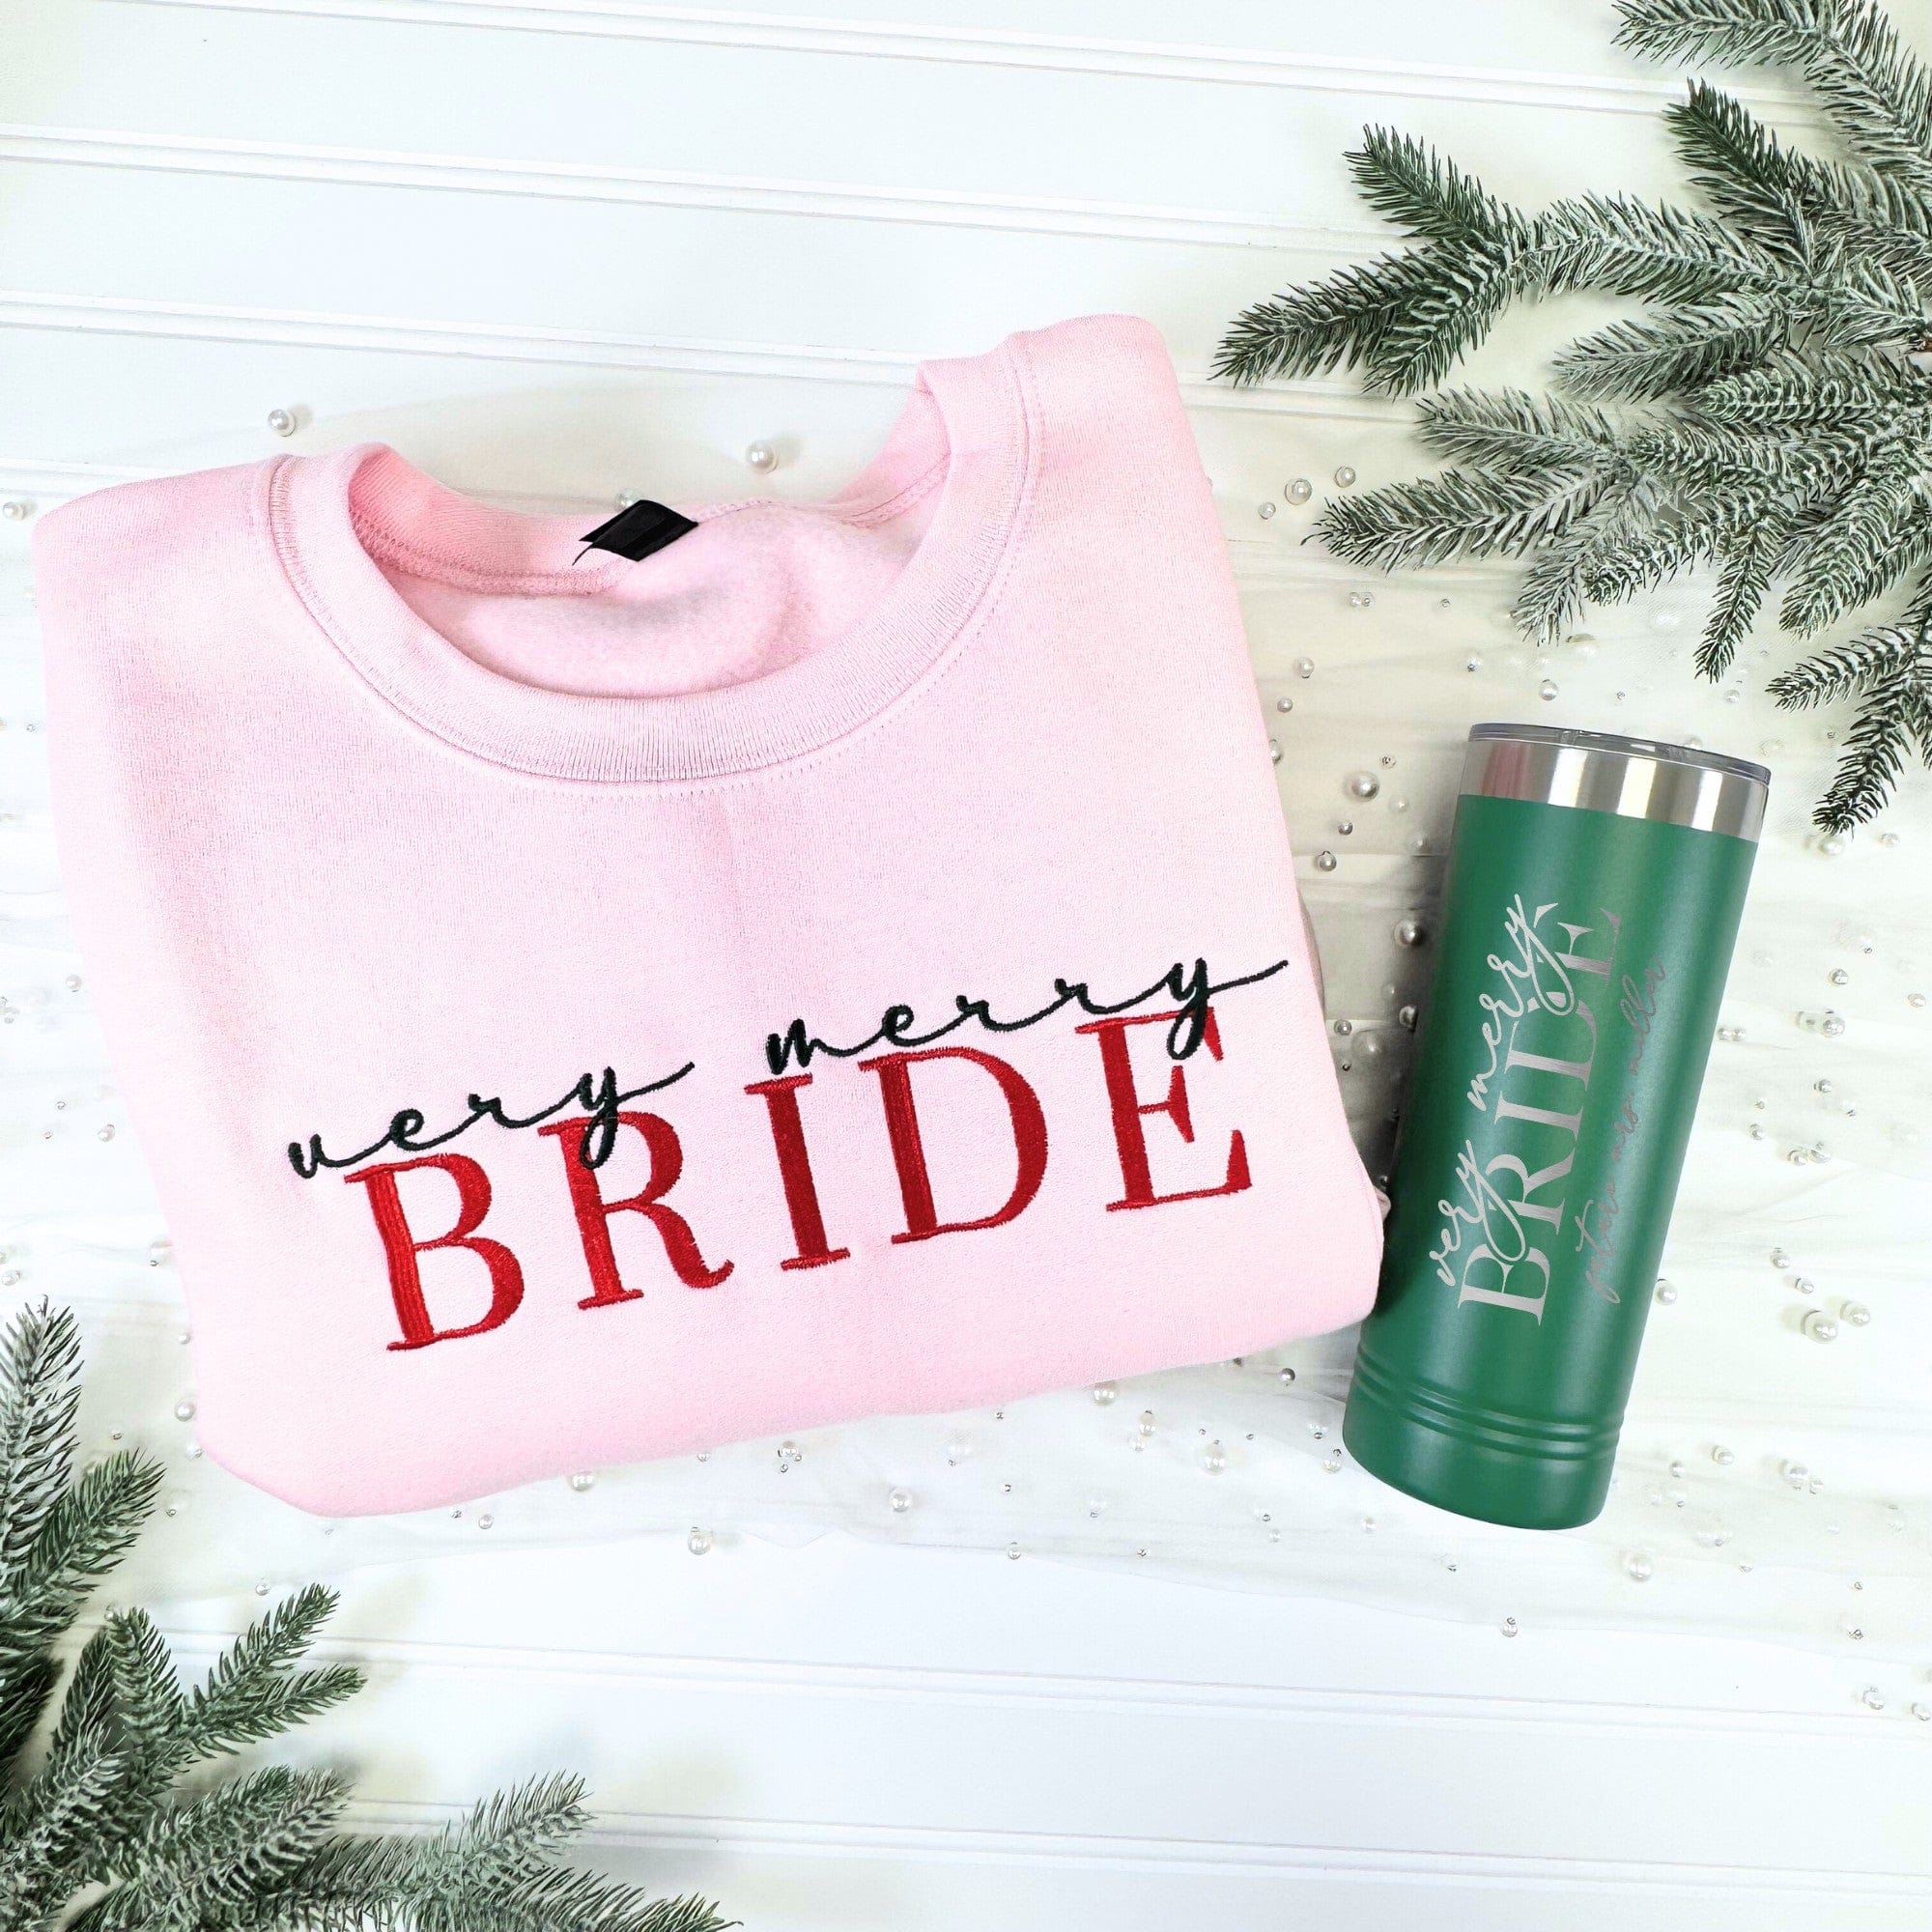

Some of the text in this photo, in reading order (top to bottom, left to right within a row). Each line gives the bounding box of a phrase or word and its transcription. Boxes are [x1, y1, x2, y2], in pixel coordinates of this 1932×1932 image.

[289, 958, 1290, 1179] very merry
[345, 1007, 1252, 1350] BRIDE
[1429, 894, 1576, 1288] very merry
[1457, 902, 1622, 1327] BRIDE
